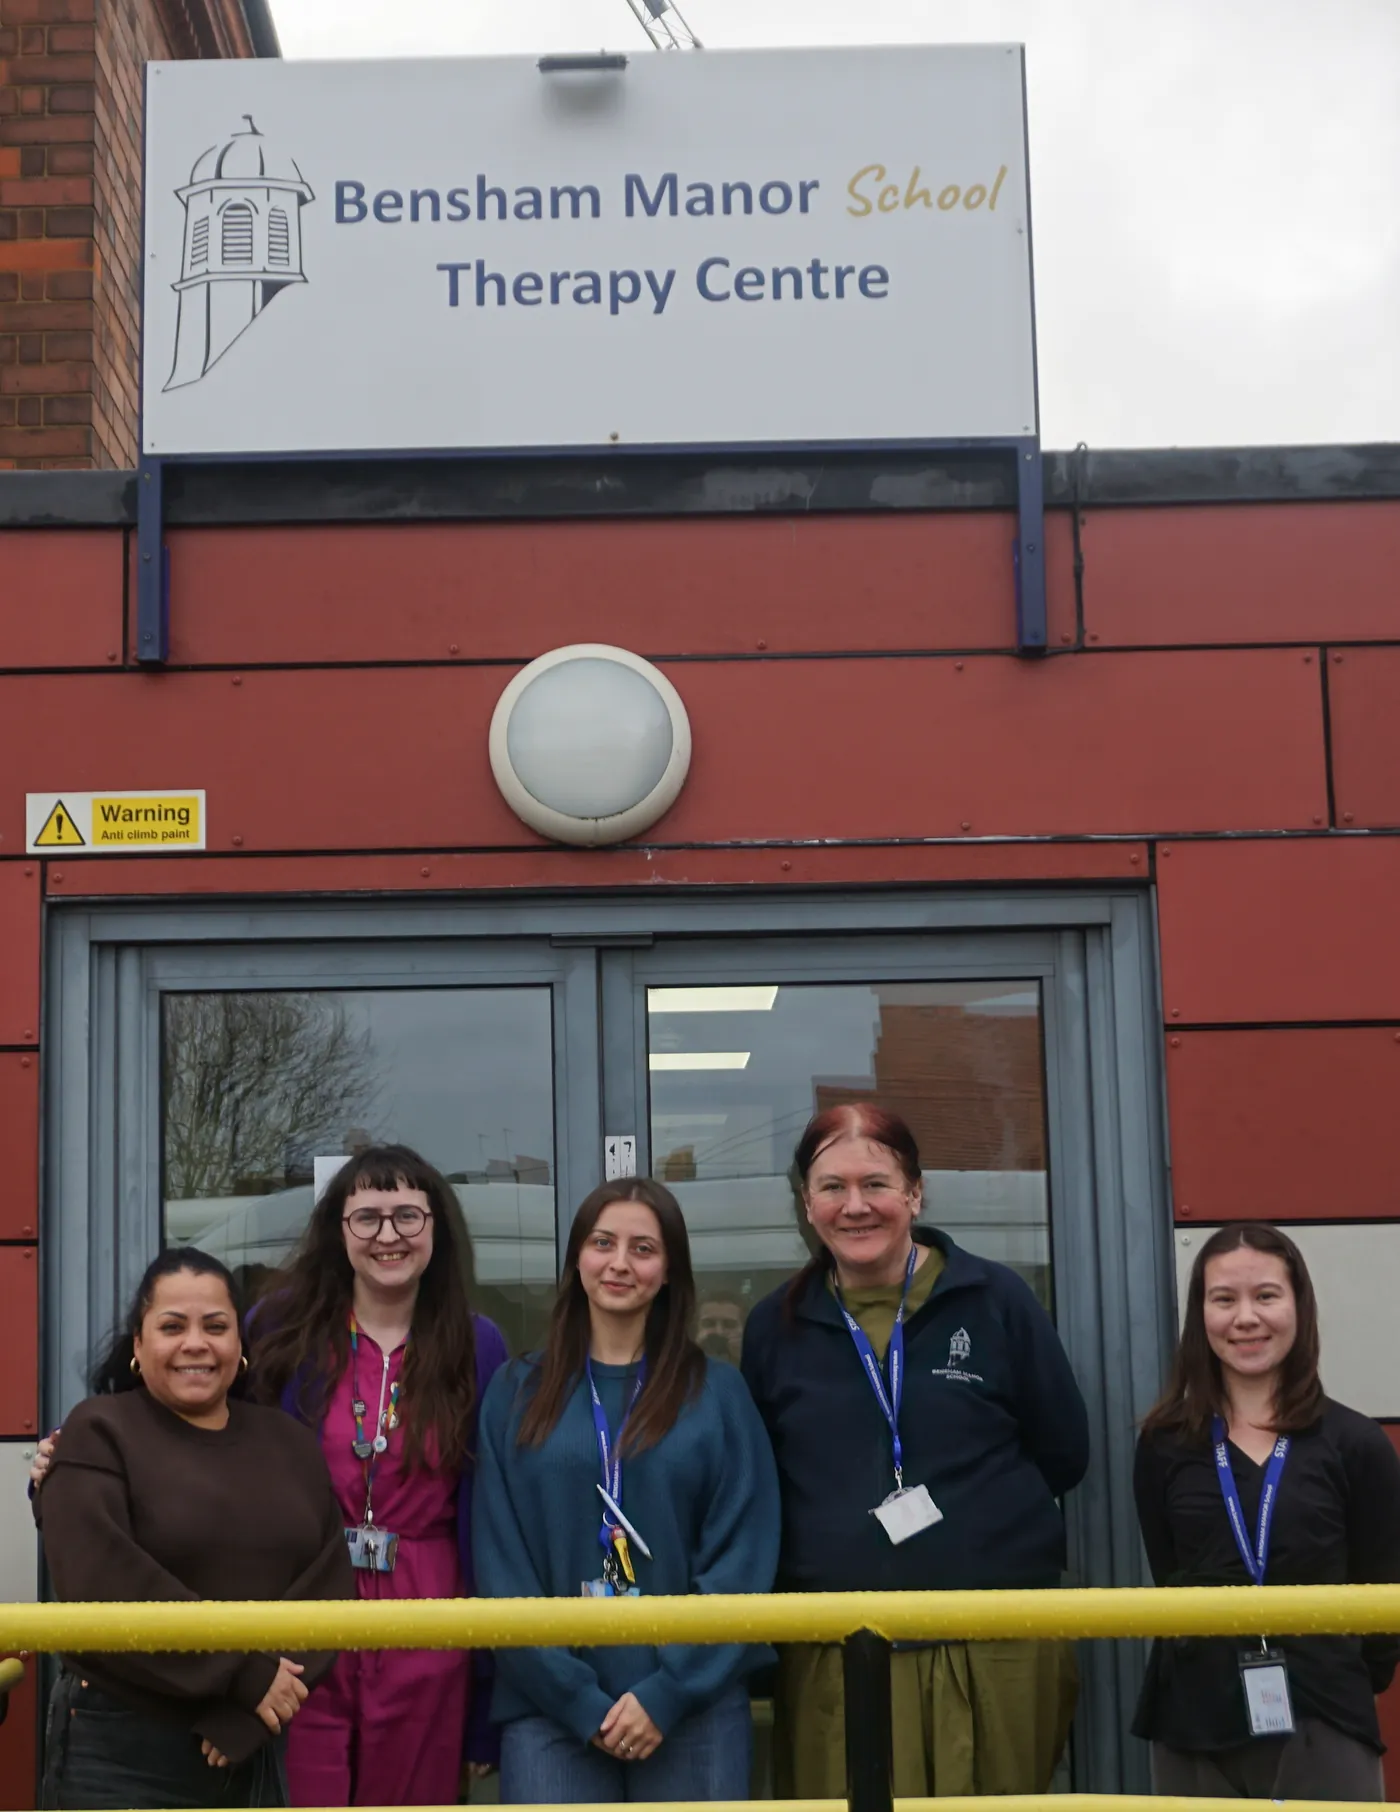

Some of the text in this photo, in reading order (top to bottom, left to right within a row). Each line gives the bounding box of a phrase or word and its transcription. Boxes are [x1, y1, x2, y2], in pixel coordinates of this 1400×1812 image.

[334, 164, 1007, 223] Bensham Manor School
[437, 257, 890, 315] Therapy Centre
[100, 804, 190, 826] Warning
[101, 829, 190, 841] Anti climb paint
[1274, 1436, 1289, 1459] STAF
